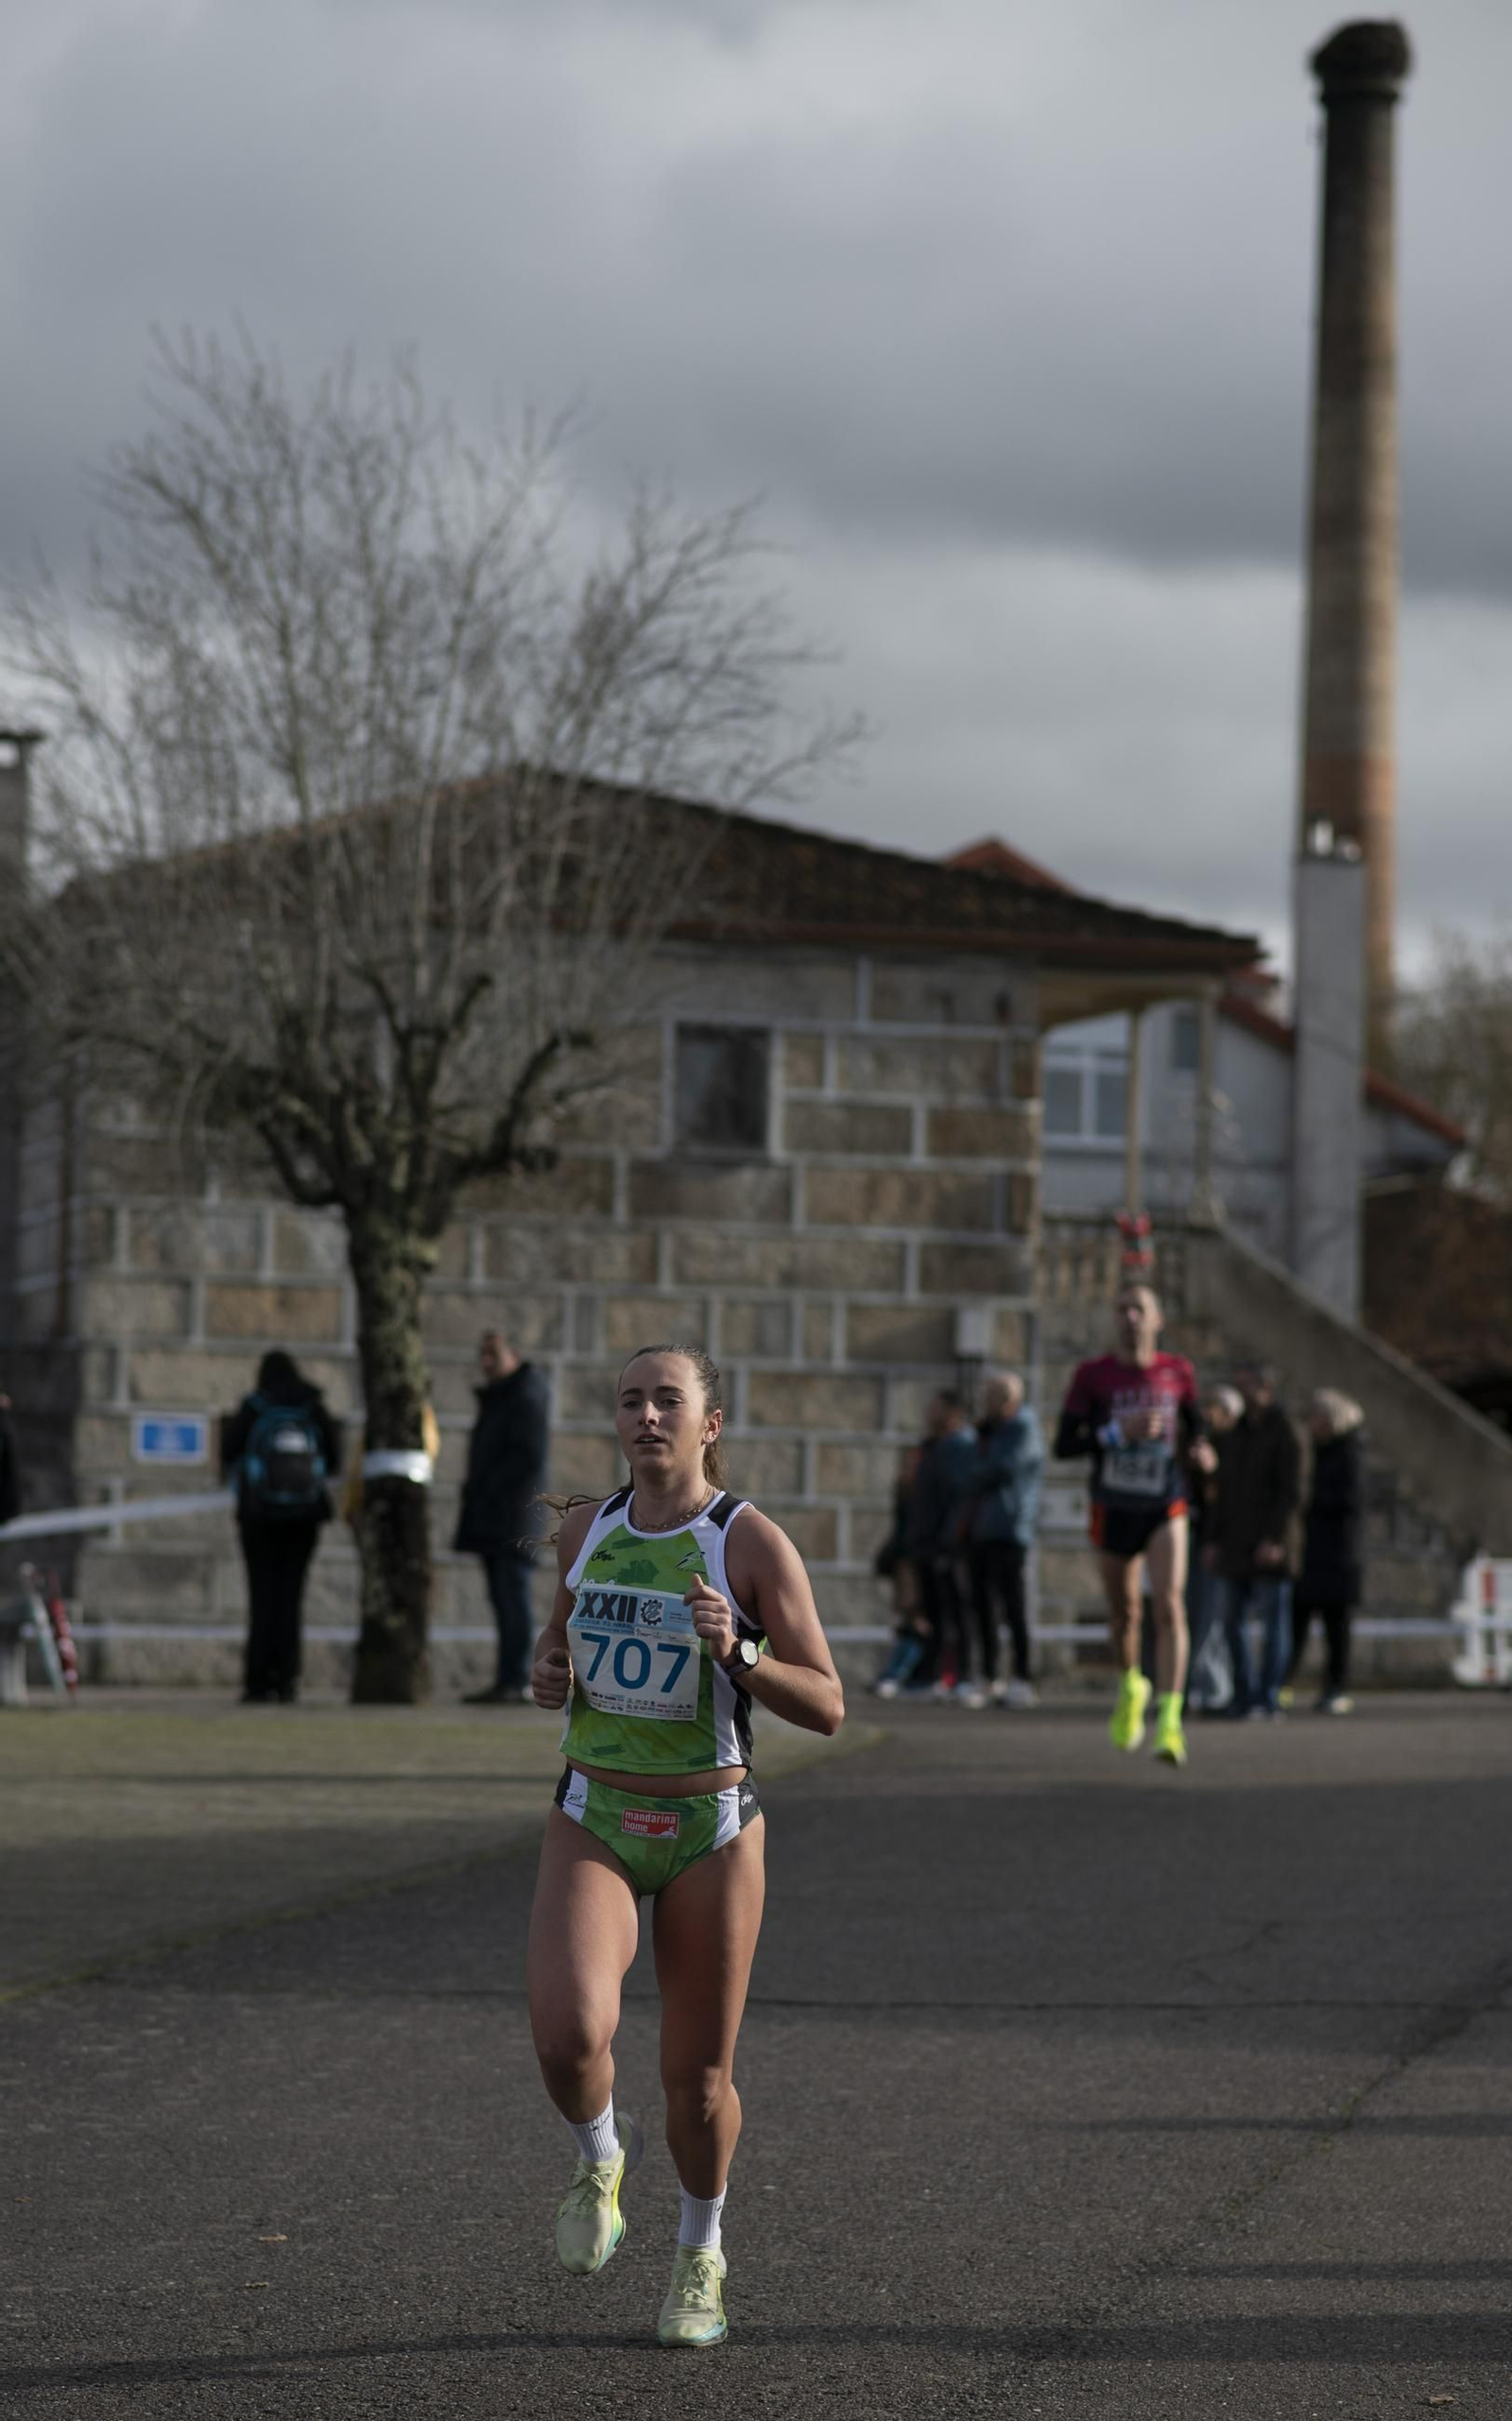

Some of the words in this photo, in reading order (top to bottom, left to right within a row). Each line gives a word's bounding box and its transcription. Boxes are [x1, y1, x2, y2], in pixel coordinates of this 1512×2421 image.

[578, 1592, 637, 1623] XXII
[581, 1633, 691, 1692] 707
[625, 1811, 676, 1824] mandarina
[625, 1820, 648, 1832] home
